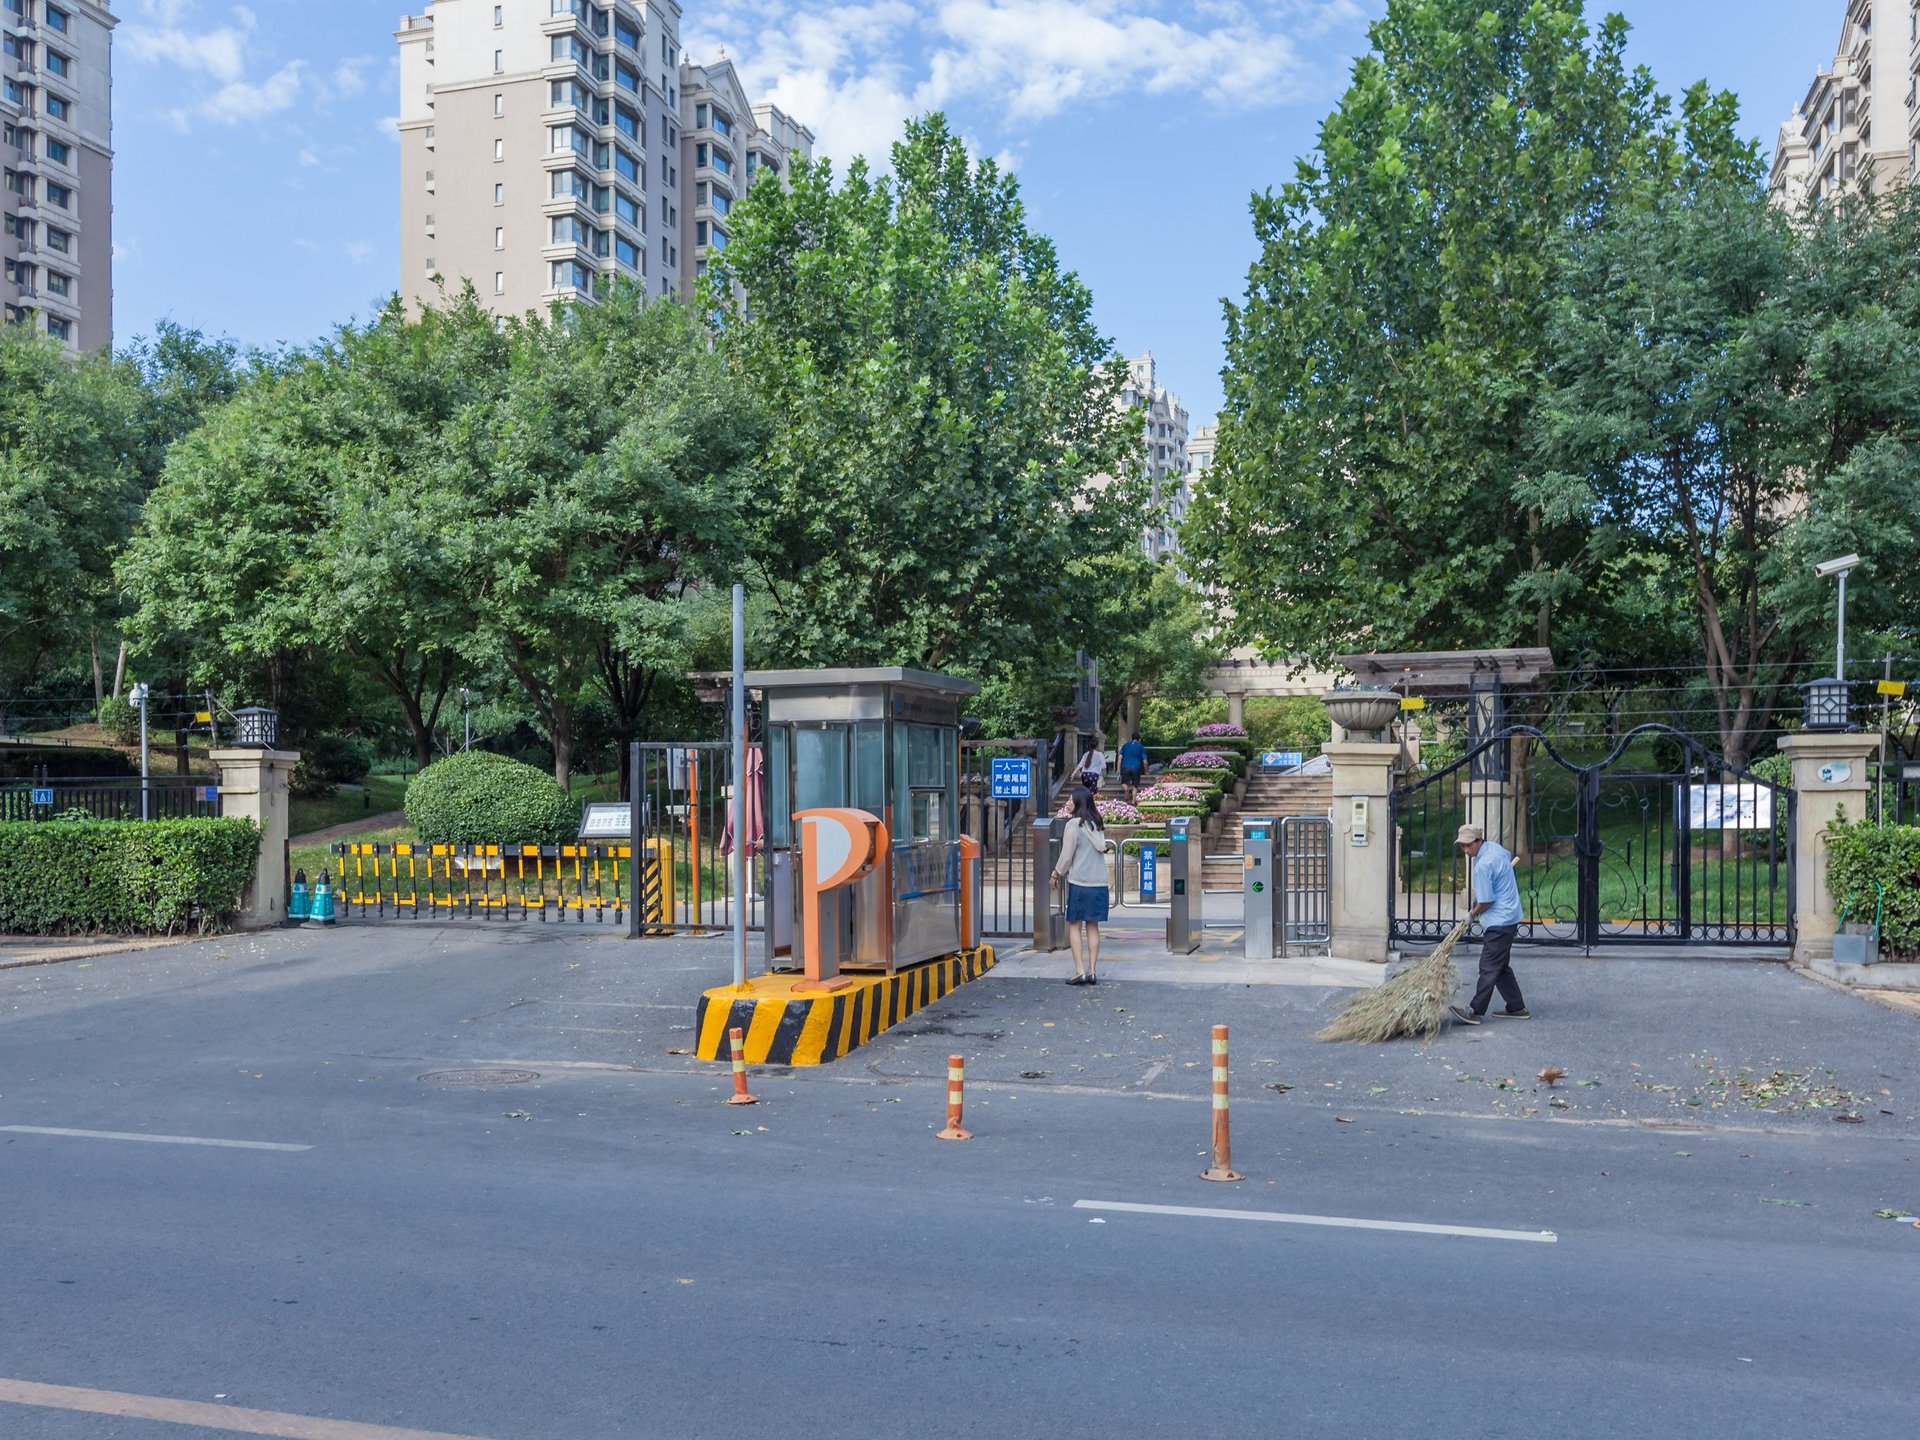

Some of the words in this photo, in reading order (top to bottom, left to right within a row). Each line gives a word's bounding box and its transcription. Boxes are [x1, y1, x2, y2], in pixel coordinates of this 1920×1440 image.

[995, 762, 1027, 771] 一人一卡
[995, 774, 1027, 783] 严禁尾随
[995, 786, 1027, 795] 禁止翻越
[1143, 850, 1153, 891] 禁止翻越
[792, 808, 886, 982] P
